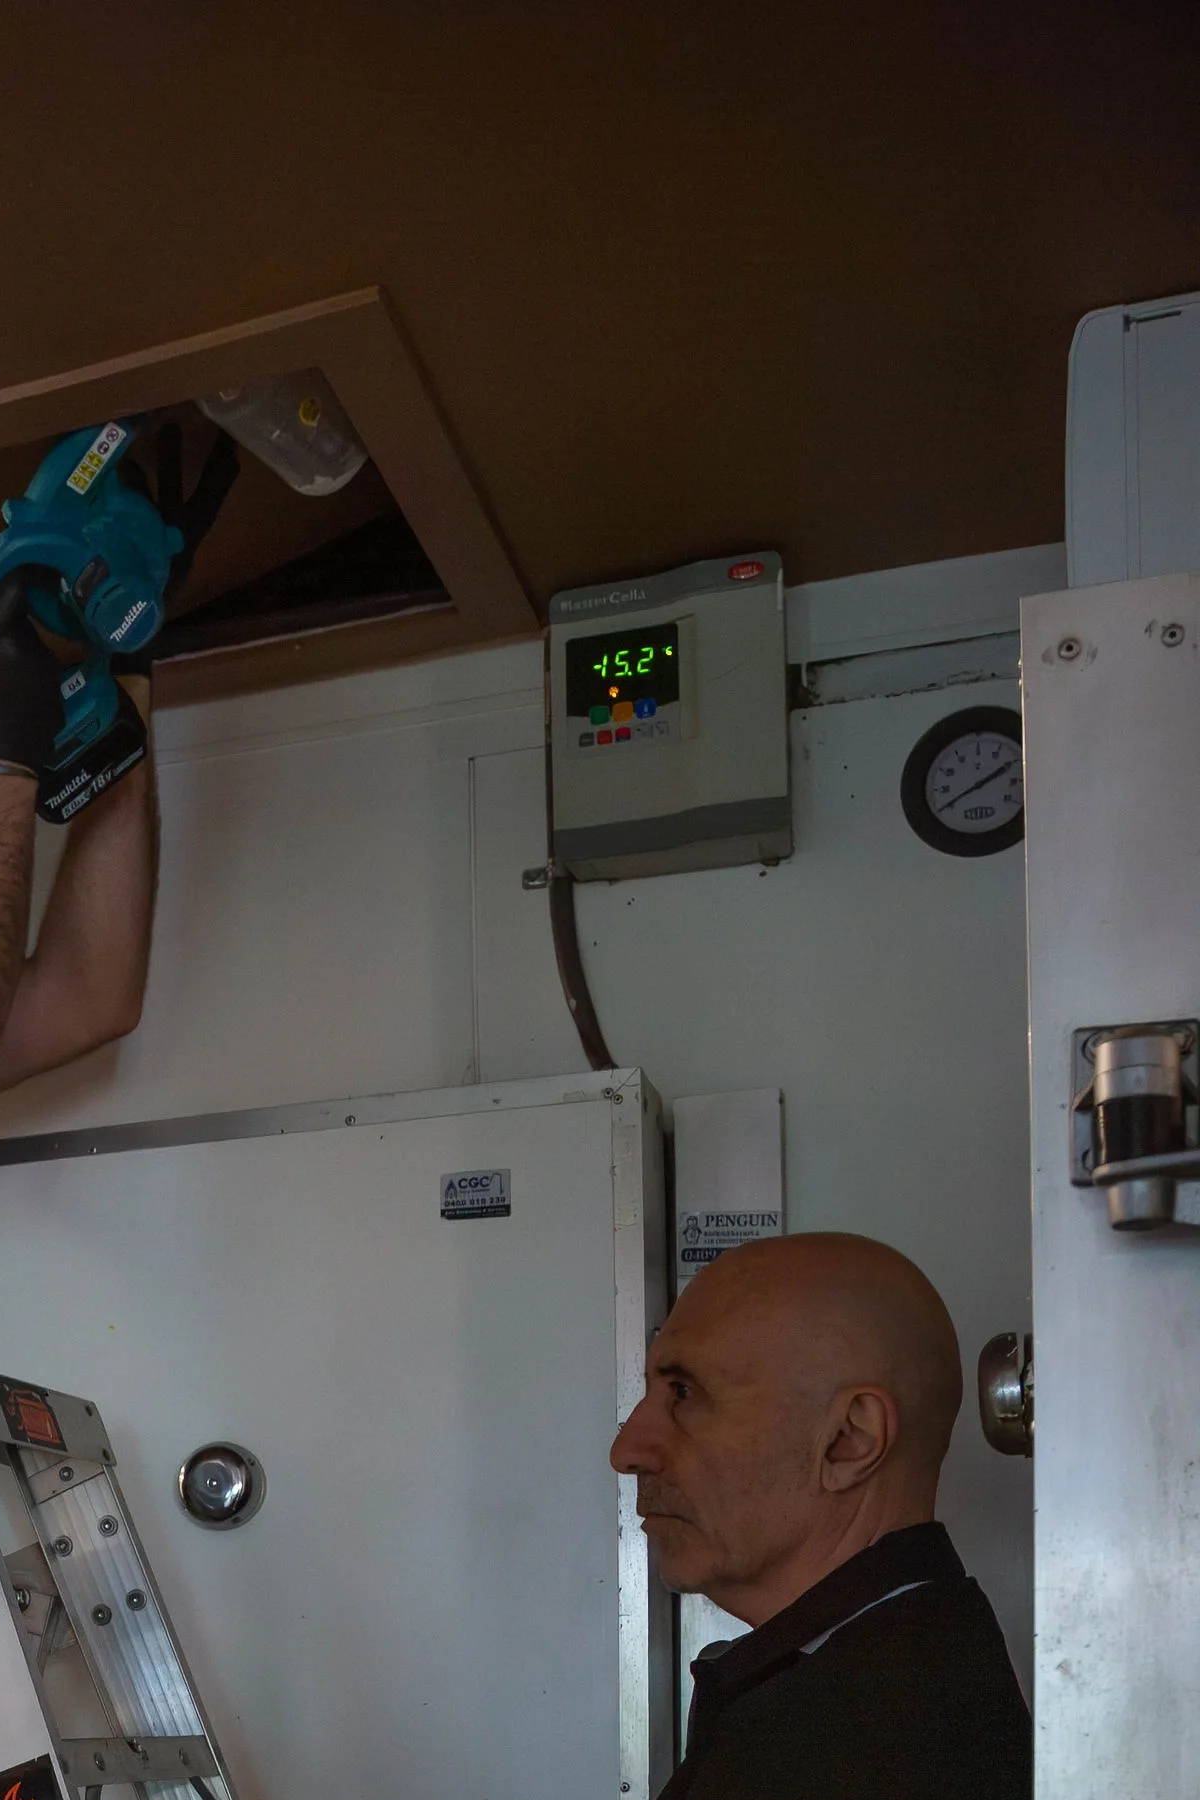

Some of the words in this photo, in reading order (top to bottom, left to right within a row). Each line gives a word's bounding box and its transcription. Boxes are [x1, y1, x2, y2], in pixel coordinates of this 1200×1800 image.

[110, 600, 147, 641] makita
[458, 1175, 490, 1189] CGC
[705, 1214, 778, 1228] PENGUIN
